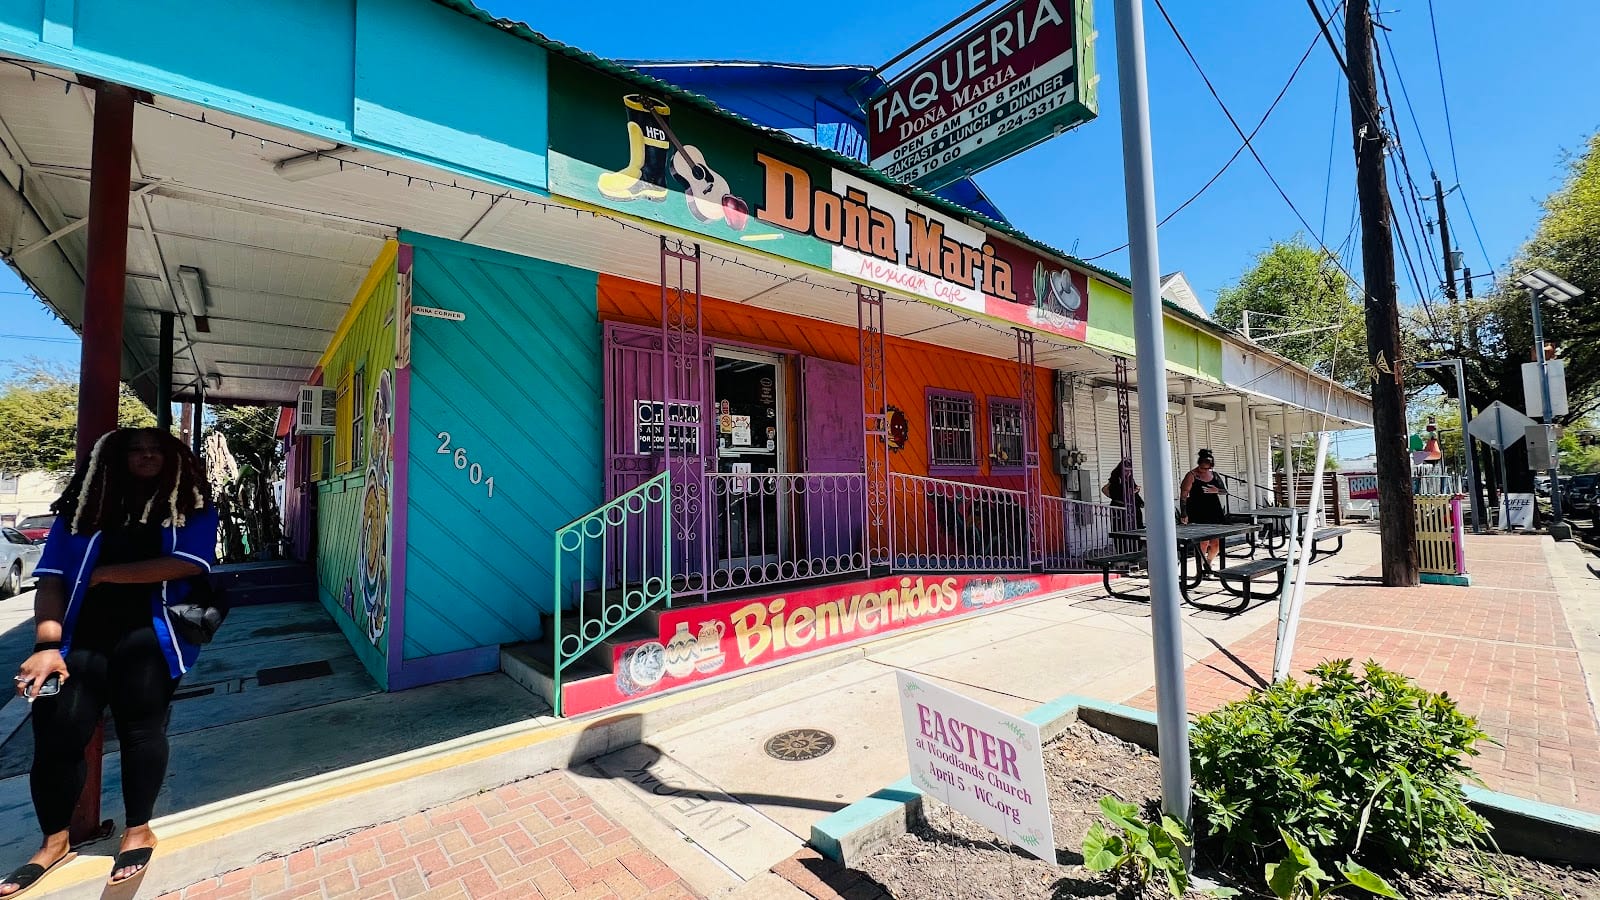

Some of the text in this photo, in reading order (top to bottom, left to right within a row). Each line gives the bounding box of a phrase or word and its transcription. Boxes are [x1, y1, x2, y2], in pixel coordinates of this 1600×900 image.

[873, 0, 1063, 133] TAQUERIA
[899, 65, 1017, 141] DOÑA MARIA
[645, 126, 666, 141] HFD
[881, 74, 1064, 178] EAKFAST LUNCH DINNER
[893, 76, 1031, 160] OPEN 6 AM TO 8 PM
[922, 157, 939, 174] TO
[943, 147, 961, 163] GO
[997, 91, 1067, 136] 224-3317
[756, 150, 1018, 302] Doña Maria
[860, 260, 967, 303] Mexican Cafe
[437, 432, 494, 498] 2601
[730, 576, 958, 665] Bienvenidos
[915, 738, 1032, 804] at Woodlands Church
[917, 703, 1022, 781] EASTER
[624, 762, 752, 841] LIVE OAK
[929, 761, 1021, 825] April 5 WC.org
